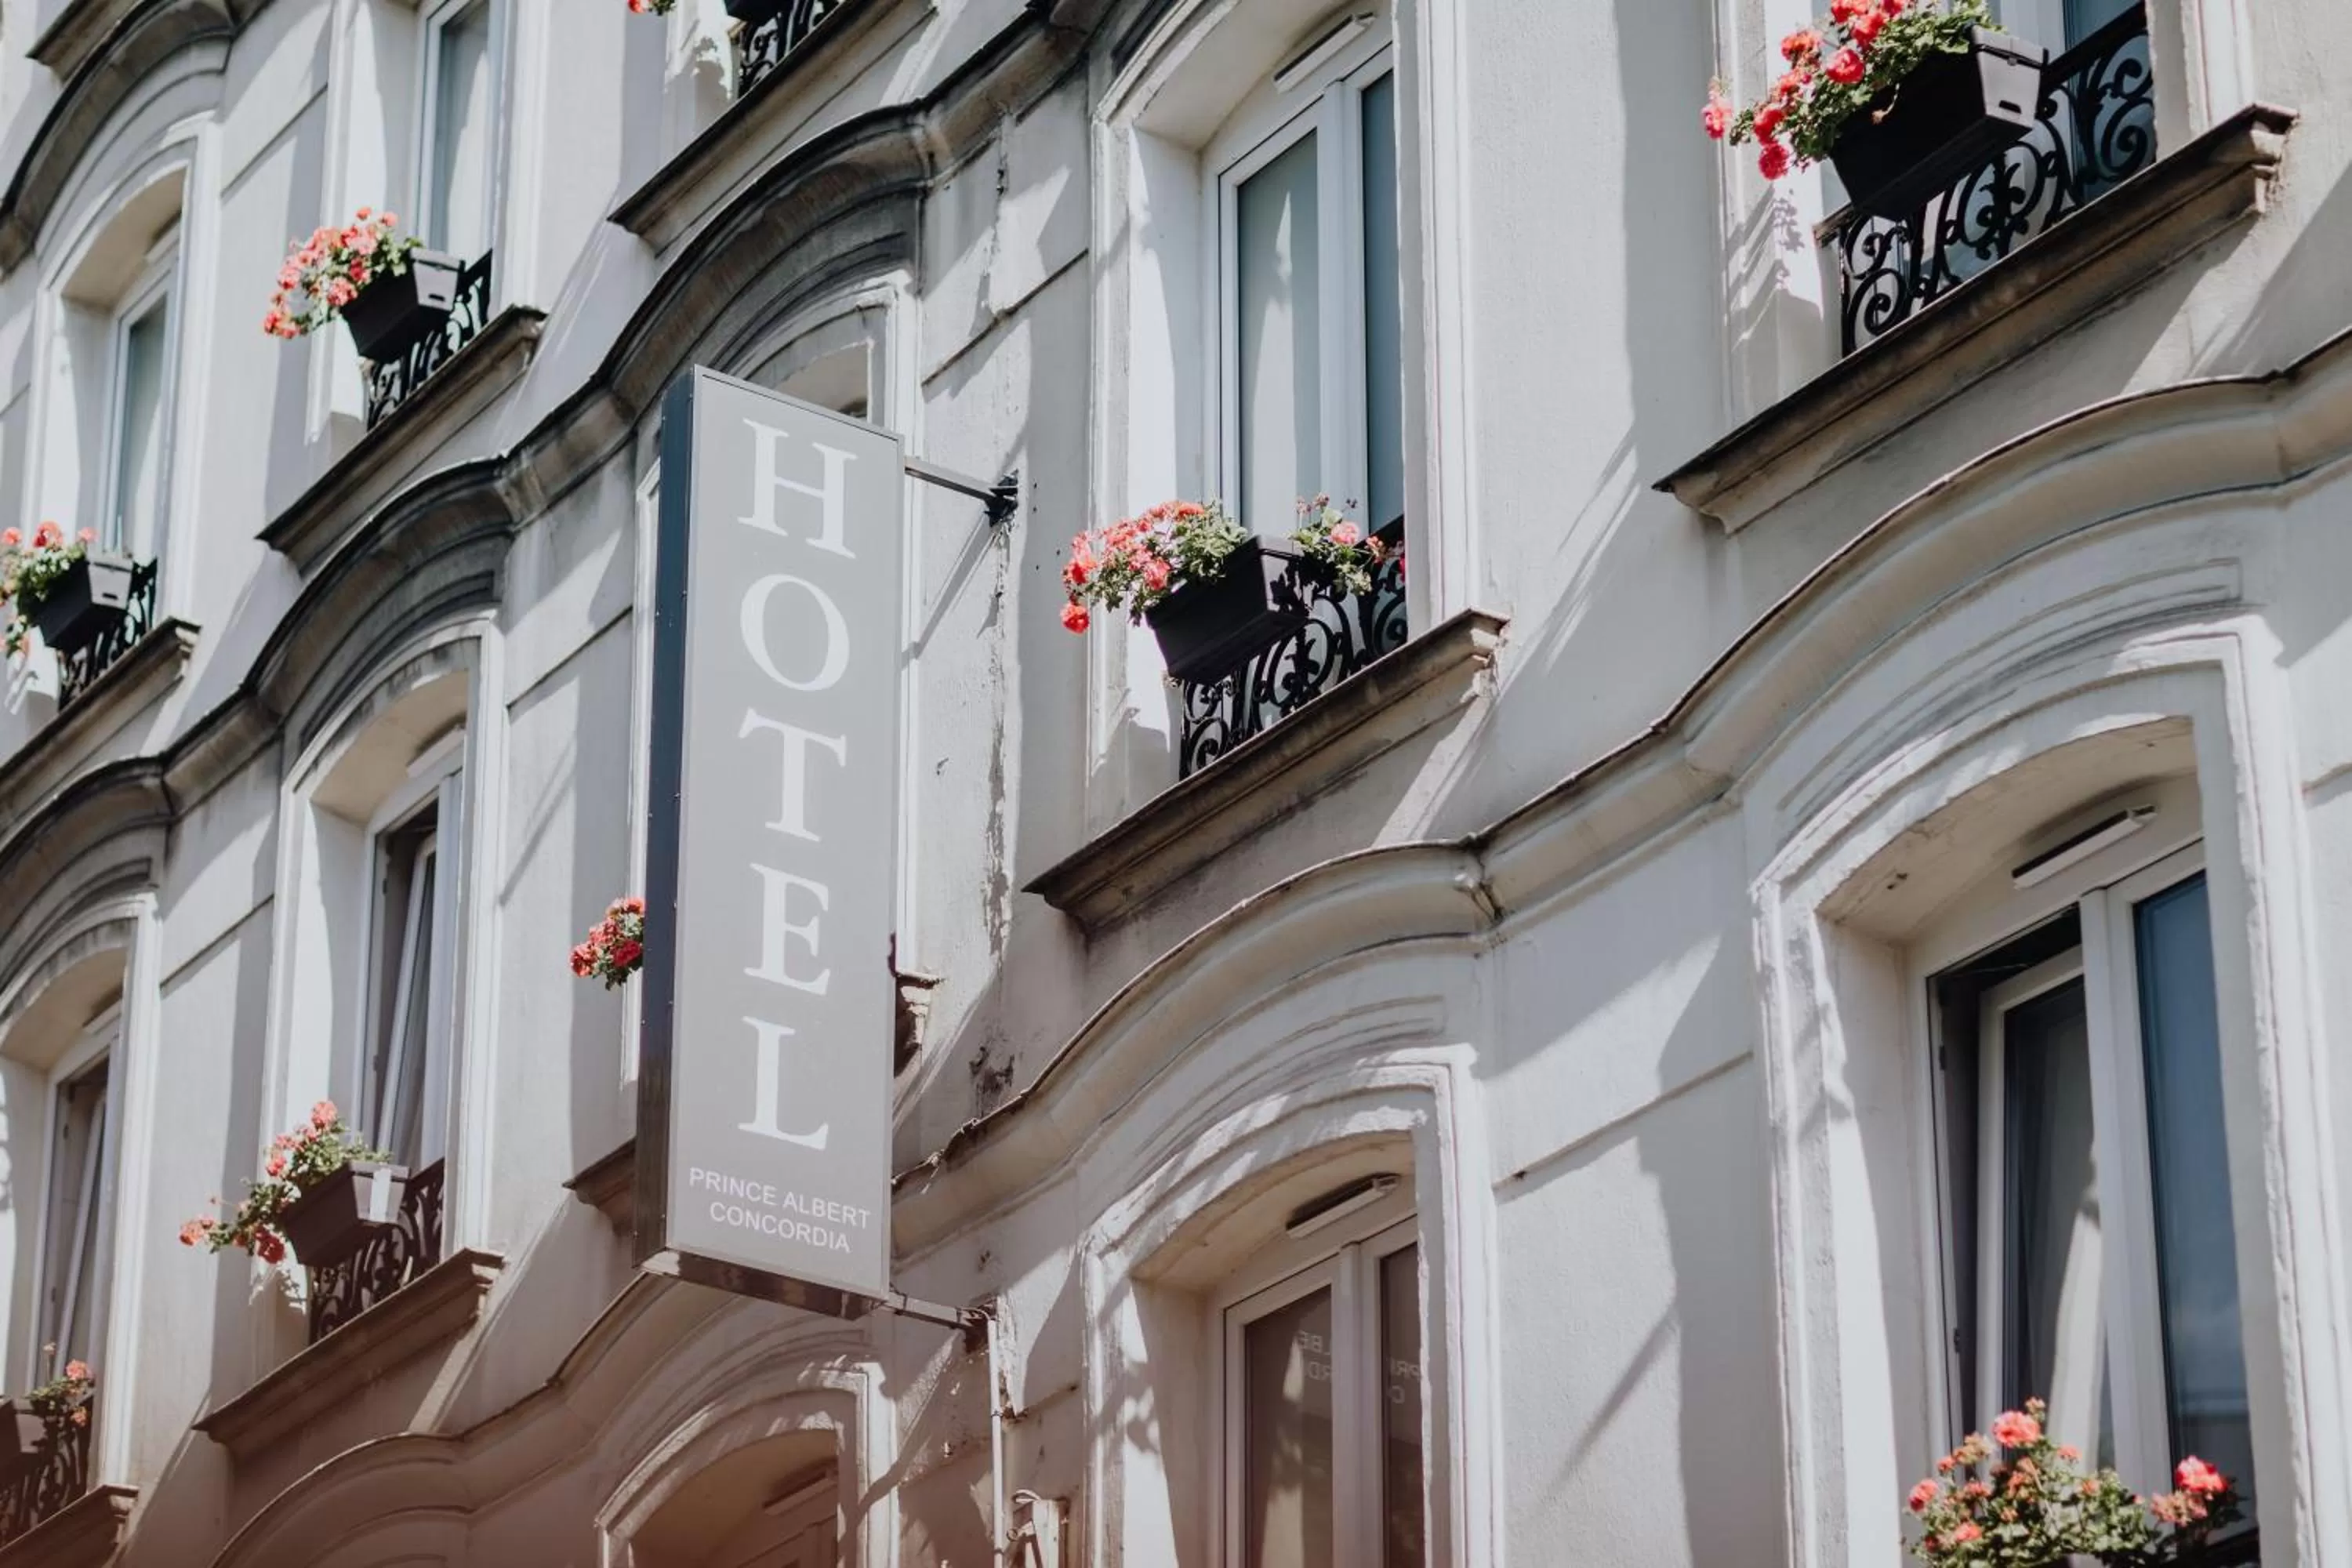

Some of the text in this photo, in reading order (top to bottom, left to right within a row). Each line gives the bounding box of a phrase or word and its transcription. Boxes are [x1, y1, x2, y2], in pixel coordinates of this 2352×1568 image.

[738, 418, 857, 1150] HOTEL
[689, 1167, 871, 1229] PRINCE ALBERT
[710, 1202, 851, 1253] CONCORDIA
